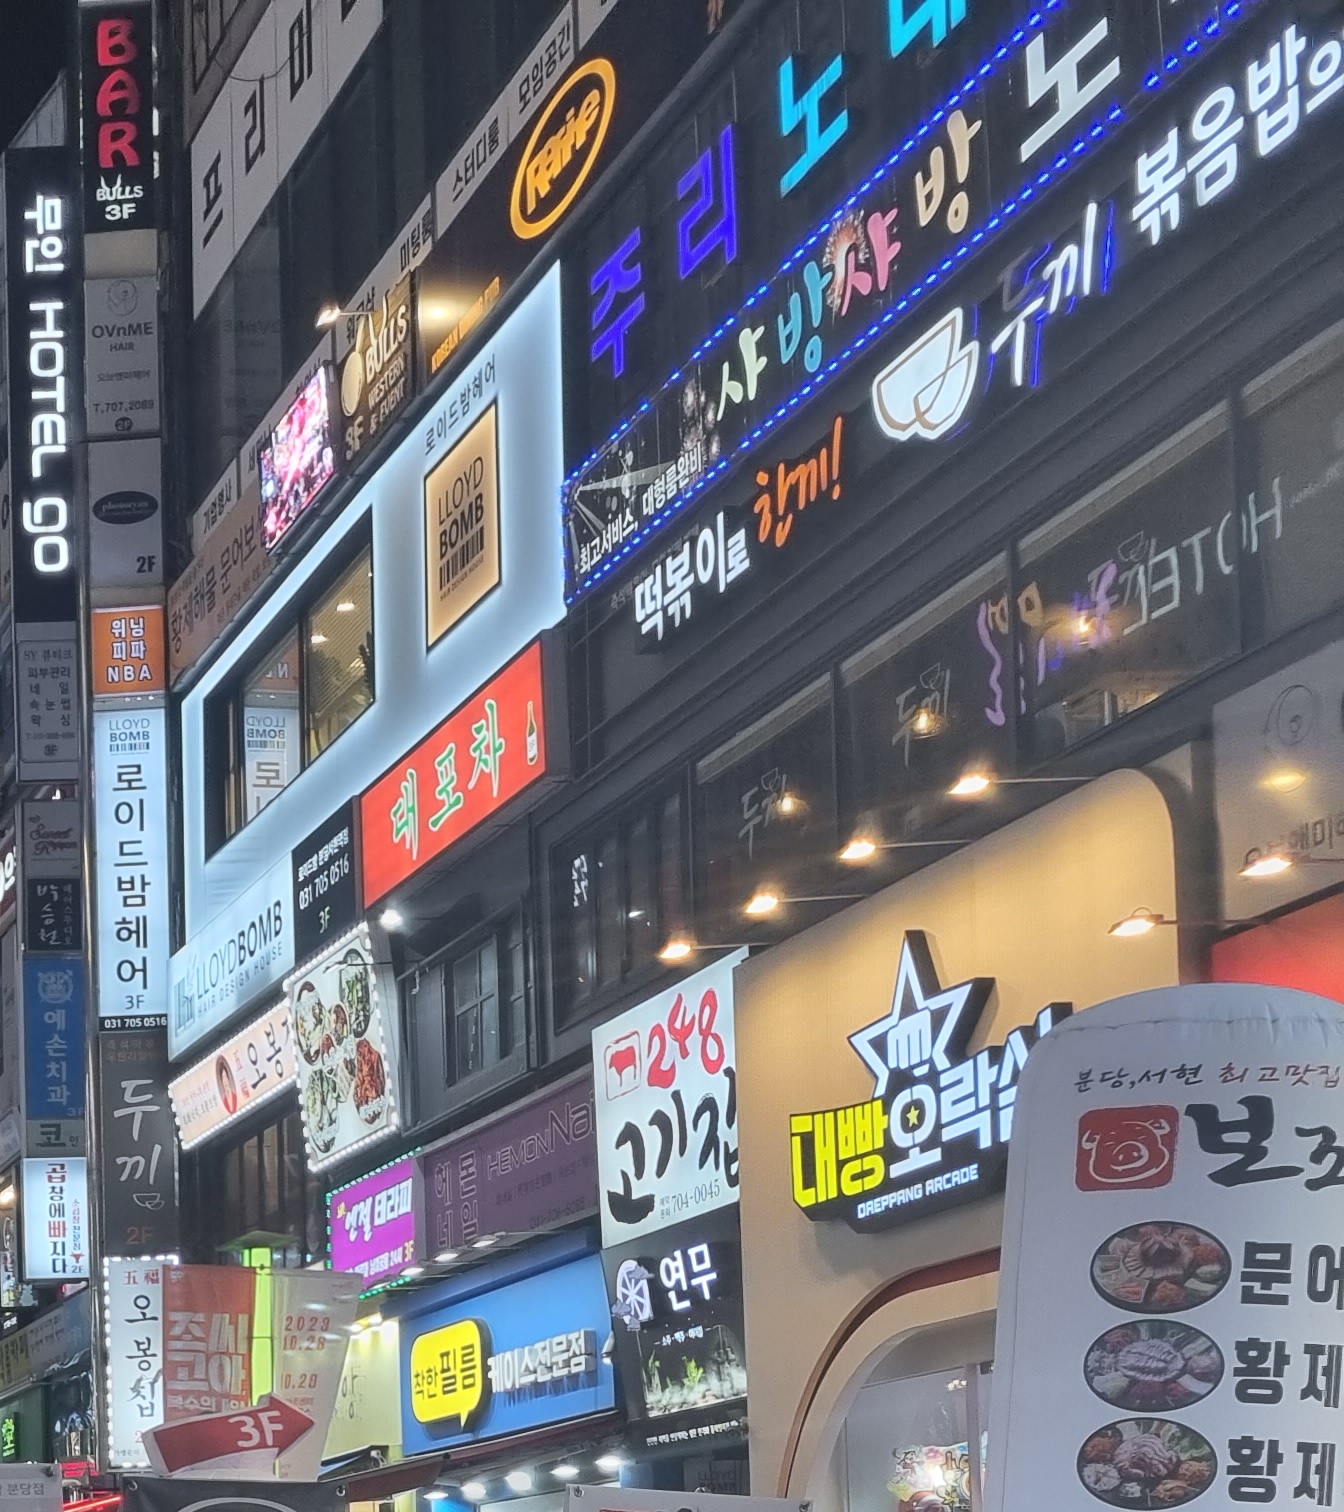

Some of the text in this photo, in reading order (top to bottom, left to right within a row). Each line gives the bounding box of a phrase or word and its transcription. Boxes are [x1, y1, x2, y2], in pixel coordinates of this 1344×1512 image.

[96, 19, 141, 169] BAR
[452, 24, 572, 202] 스터디룸 모임공간
[95, 175, 144, 202] BULLS
[104, 204, 137, 221] 3F
[366, 303, 407, 385] BULLS
[23, 195, 69, 573] 무인 HOTEL go
[425, 353, 496, 456] 로이드밤헤어
[437, 455, 485, 523] LLOYD
[439, 494, 485, 558] BOMB
[136, 556, 156, 574] 2F
[634, 509, 751, 641] 떡볶이로
[111, 618, 145, 638] 위닝
[112, 641, 146, 660] 피파
[107, 665, 153, 683] NBA
[108, 718, 151, 731] LLOYD
[109, 731, 150, 743] BOMB
[391, 697, 505, 861] 대포차
[112, 764, 152, 990] 로이드밤헤어
[319, 906, 330, 933] 3F
[197, 941, 283, 1018] HAIR DESIGN HOUSE
[125, 996, 145, 1010] 3F
[104, 1017, 167, 1029] 031 705 0516
[647, 988, 725, 1087] 248
[44, 1009, 70, 1106] 예손치과
[114, 1079, 161, 1186] 두끼
[671, 1180, 721, 1212] 704-0045
[857, 1163, 979, 1218] DAEPPANG ARCADE
[127, 1228, 152, 1244] 2F
[71, 1265, 84, 1273] 2F
[660, 1243, 718, 1314] 연무
[285, 1316, 330, 1332] 2023
[228, 1410, 283, 1447] 3F
[7, 1482, 44, 1495] 분당점
